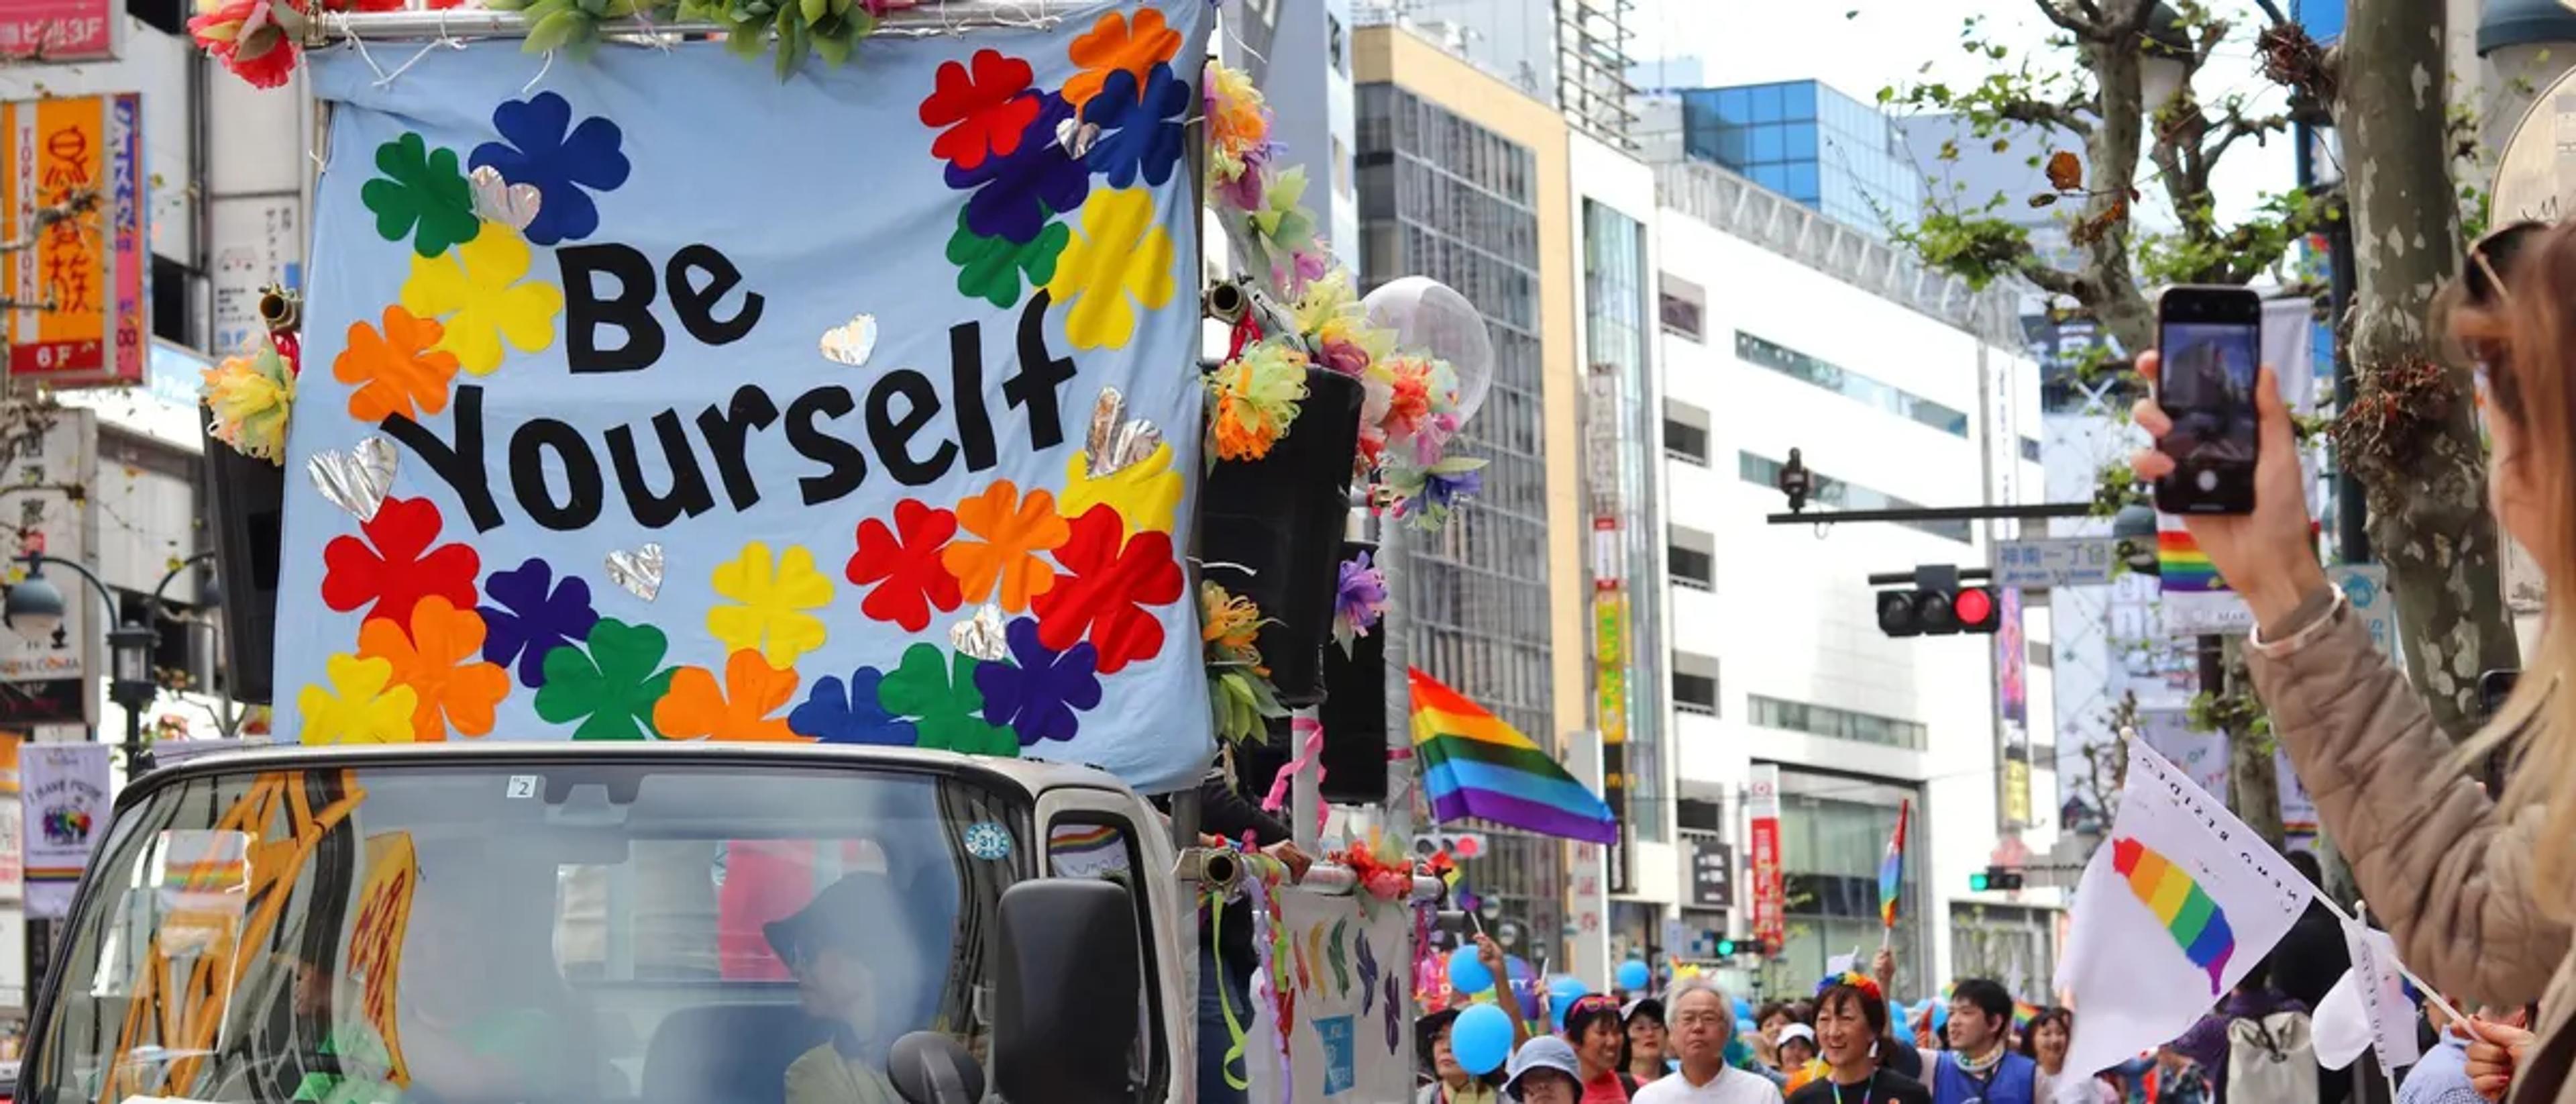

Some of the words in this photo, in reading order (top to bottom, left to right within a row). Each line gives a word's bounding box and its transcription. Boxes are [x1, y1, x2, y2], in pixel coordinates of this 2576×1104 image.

[556, 242, 765, 374] Be
[380, 288, 1077, 534] Yourself
[517, 781, 529, 795] 2
[979, 835, 994, 847] 31
